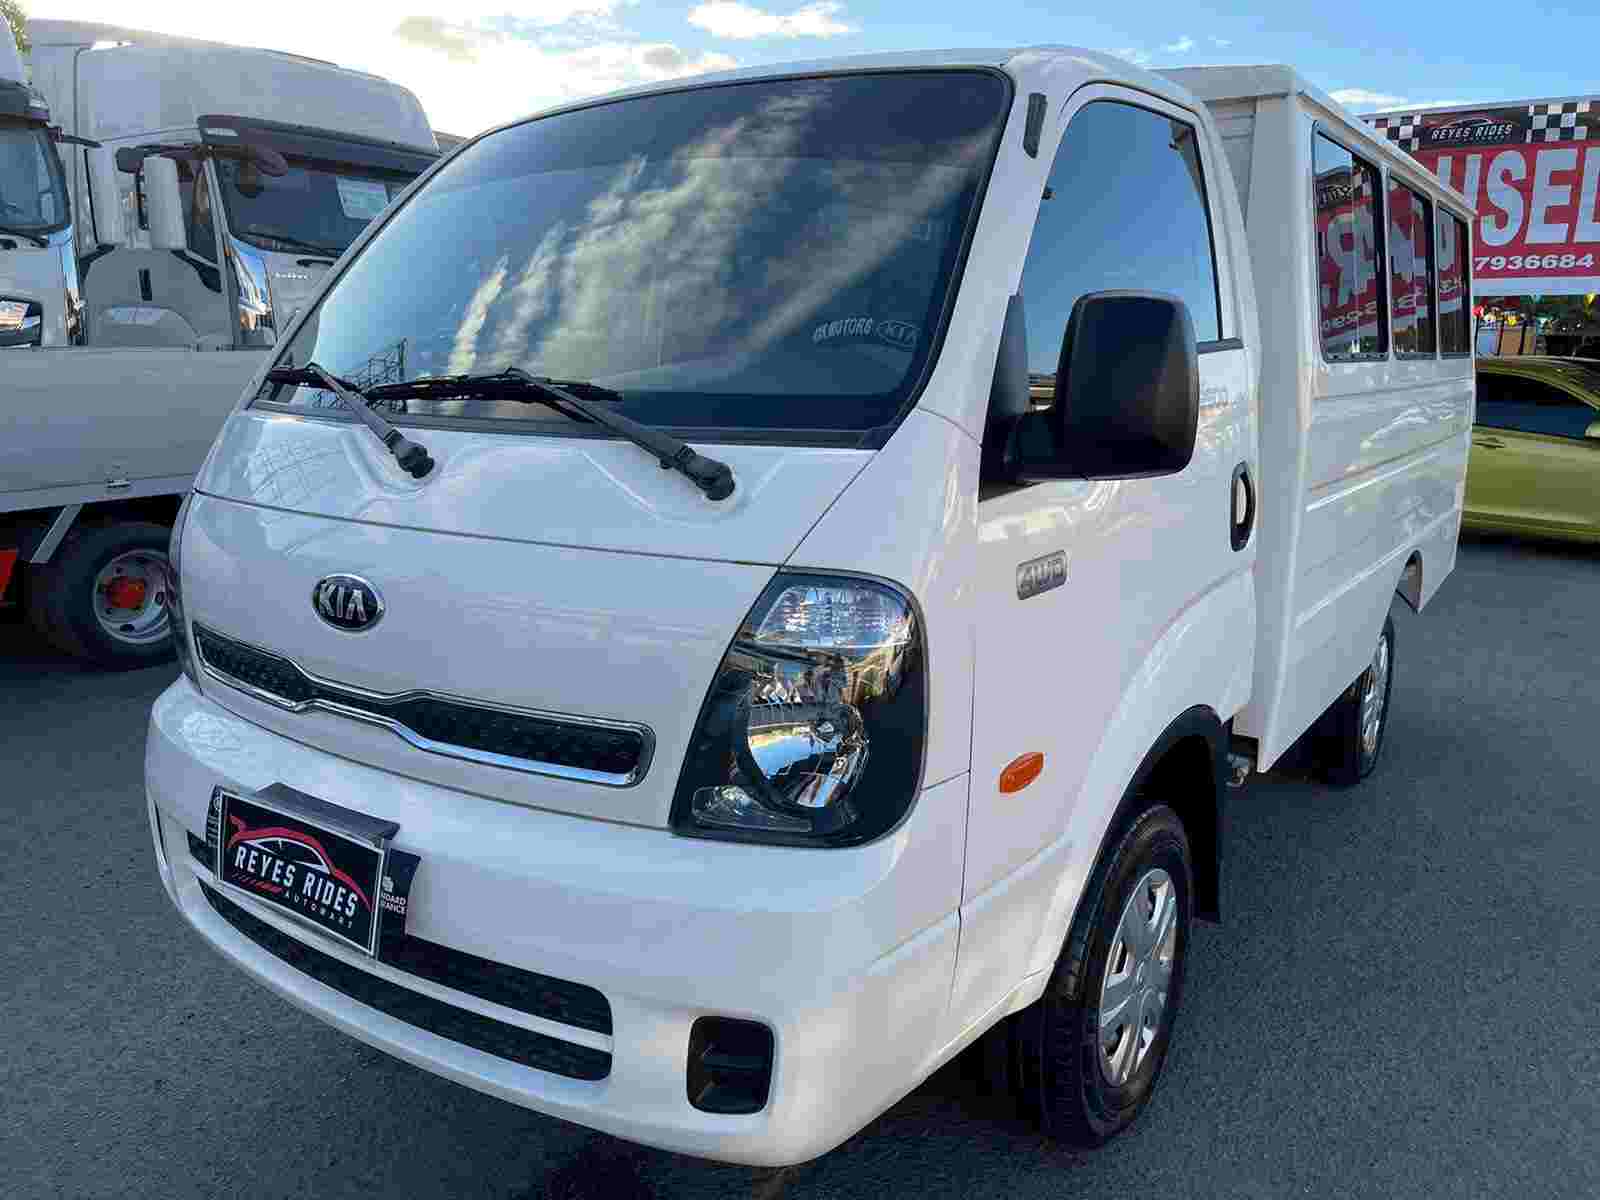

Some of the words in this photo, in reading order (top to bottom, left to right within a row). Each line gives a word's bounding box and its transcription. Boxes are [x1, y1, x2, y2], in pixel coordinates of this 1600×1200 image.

[1432, 126, 1472, 140] REYES
[1475, 124, 1513, 138] RIDES
[1473, 254, 1594, 271] 7936684
[319, 583, 368, 621] KIA
[234, 845, 296, 887] REYES
[303, 871, 358, 917] RIDES
